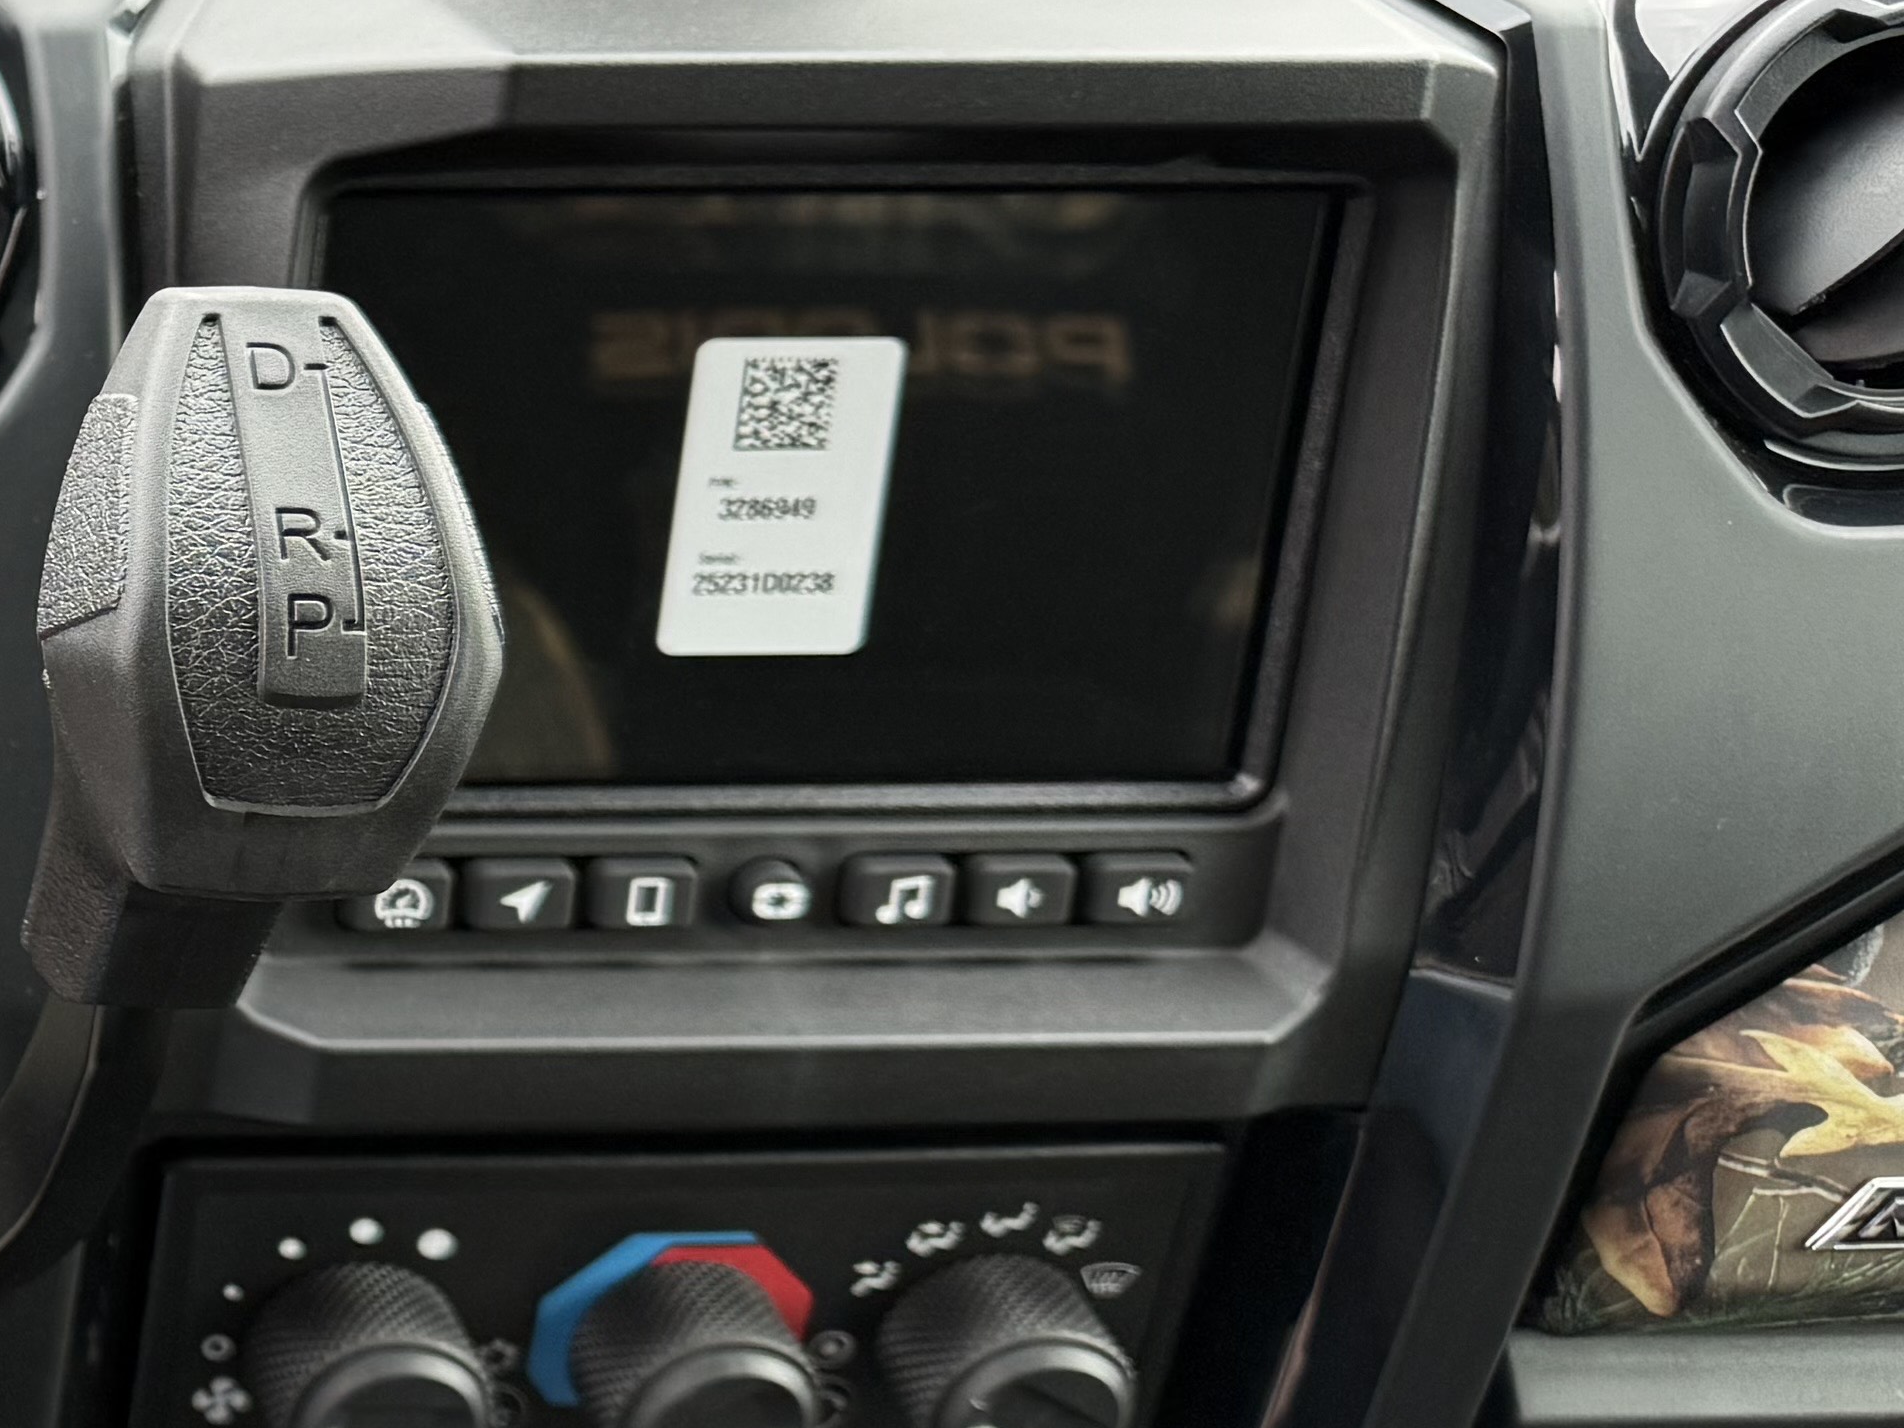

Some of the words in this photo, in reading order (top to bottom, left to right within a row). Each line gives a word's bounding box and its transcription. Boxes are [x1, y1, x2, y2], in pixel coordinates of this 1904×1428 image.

[246, 341, 296, 390] D
[275, 507, 331, 561] R
[286, 593, 335, 658] P
